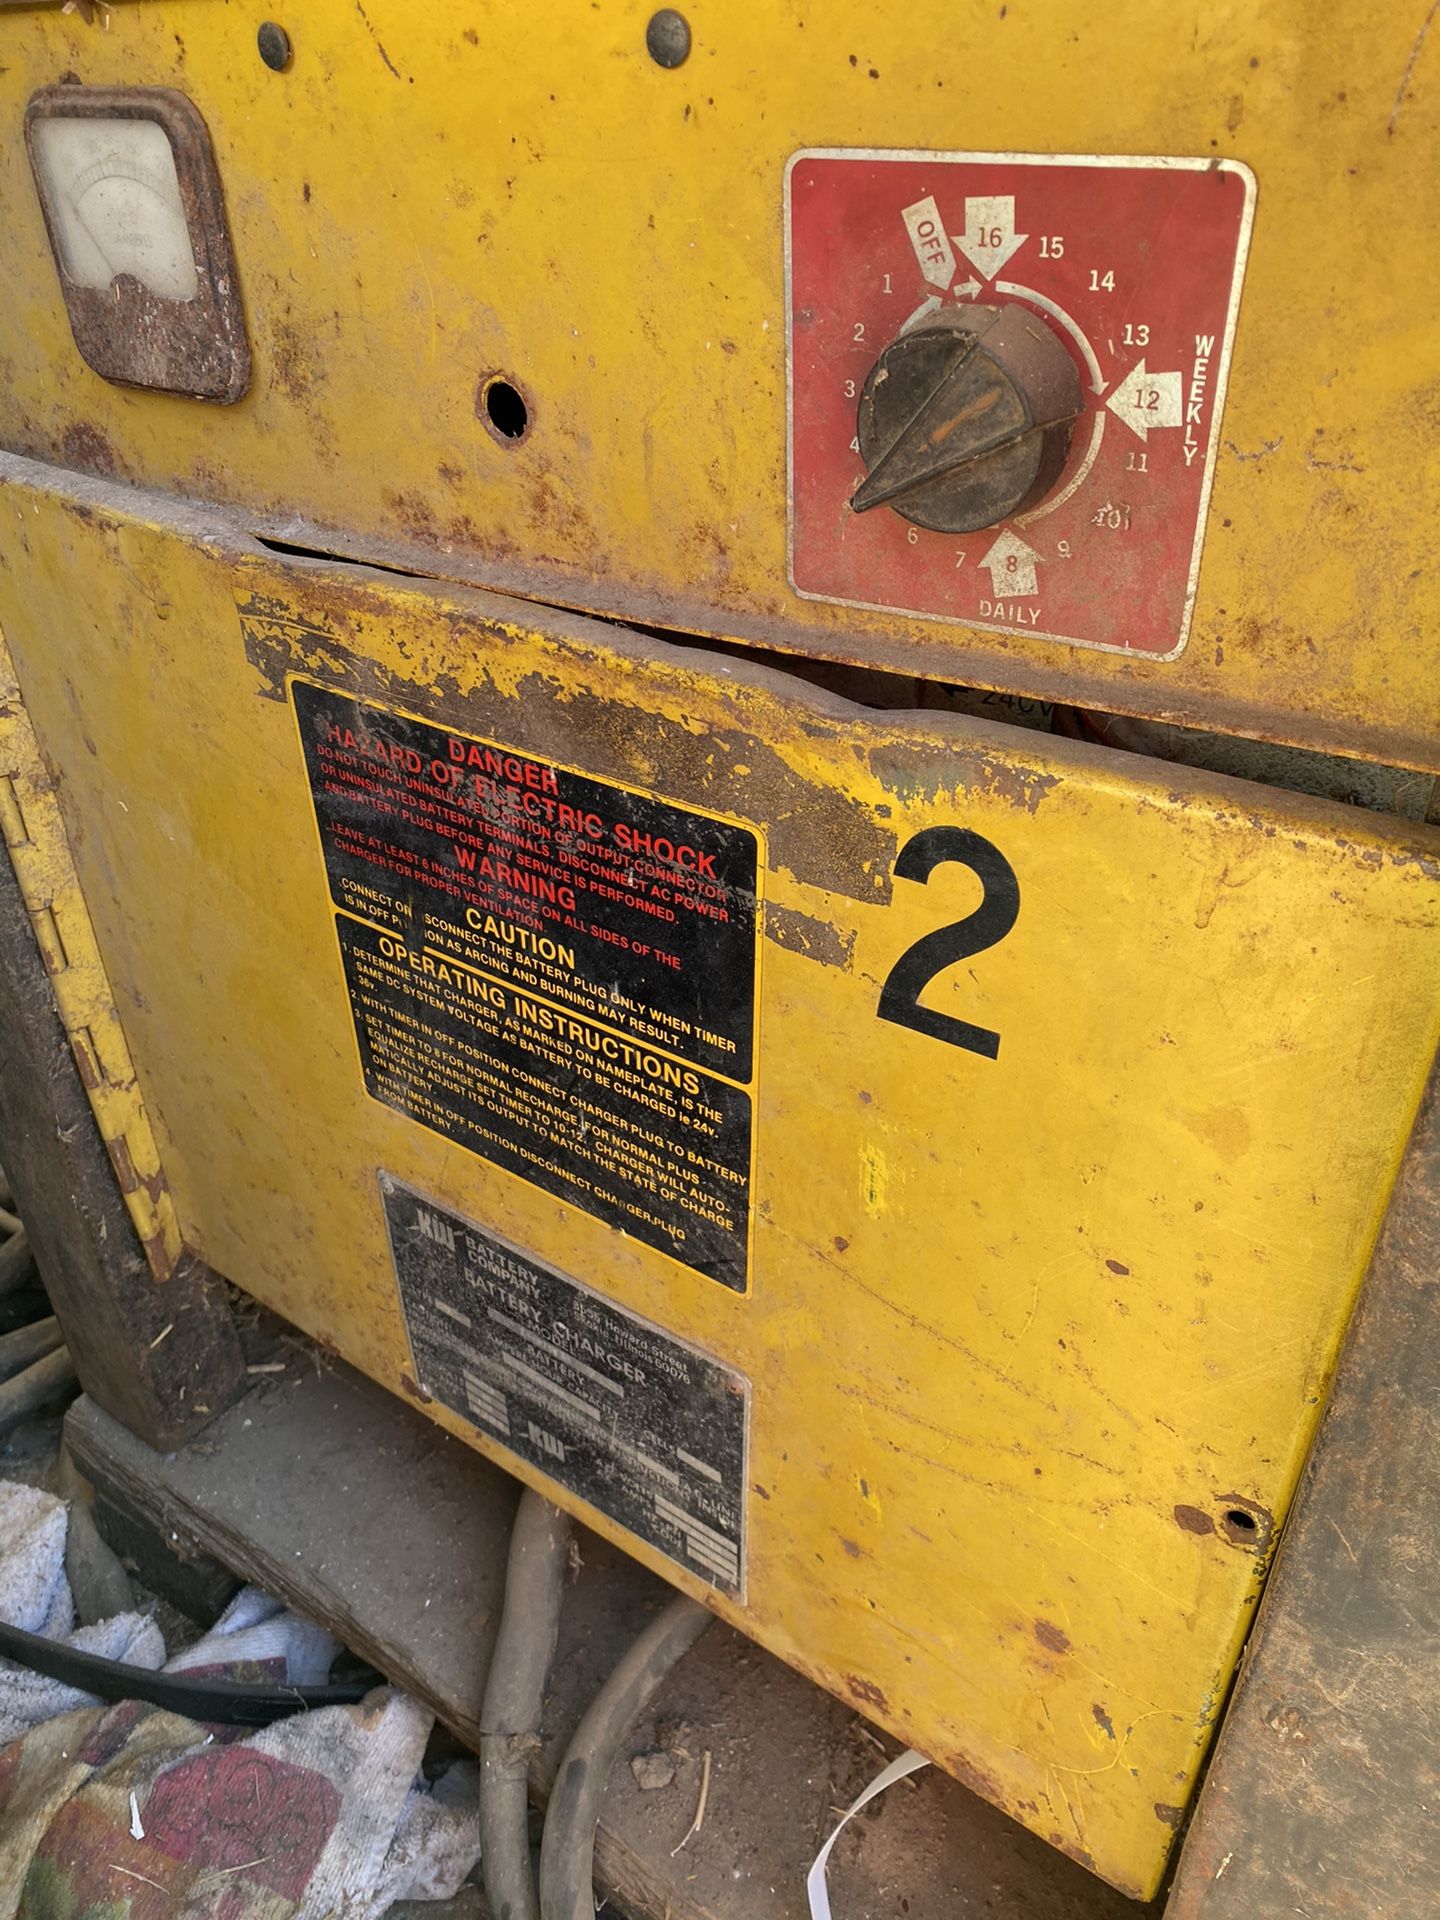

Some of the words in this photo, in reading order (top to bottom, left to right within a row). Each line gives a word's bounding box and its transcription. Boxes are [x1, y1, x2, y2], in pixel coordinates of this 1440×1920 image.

[917, 220, 945, 265] OFF
[978, 227, 1002, 247] 16
[1039, 237, 1064, 258] 15
[883, 275, 892, 292] 1
[1088, 271, 1115, 291] 14
[853, 324, 864, 341] 2
[1122, 325, 1150, 345] 13
[844, 381, 855, 397] 3
[1134, 391, 1160, 410] 12
[1183, 335, 1214, 466] WEEKLY
[1127, 453, 1148, 472] 11
[908, 528, 917, 544] 6
[957, 552, 966, 568] 7
[1006, 556, 1018, 572] 8
[1058, 541, 1070, 558] 9
[979, 600, 1042, 625] DAILY
[447, 737, 558, 796] DANGER
[324, 720, 422, 775] HAZARD
[430, 757, 465, 790] OF
[474, 772, 602, 839] ELECTRIC
[614, 821, 717, 880] SHOCK
[362, 760, 401, 785] TOUCH
[576, 837, 629, 868] OUTPUT
[634, 858, 726, 903] CONNECTOR
[319, 761, 337, 777] OR
[337, 768, 416, 807] UNINSULATED
[419, 798, 473, 828] BATTERY
[477, 819, 553, 858] TERMINALS.
[559, 849, 646, 893] DISCONNECT
[650, 883, 669, 902] AC
[675, 892, 728, 923] POWER
[402, 809, 432, 831] PLUG
[435, 822, 483, 850] BEFORE
[486, 841, 512, 861] ANY
[516, 852, 570, 883] SERVICE
[574, 874, 586, 889] IS
[590, 880, 679, 925] PERFORMED.
[331, 822, 365, 844] LEAVE
[367, 836, 381, 850] AT
[384, 842, 419, 865] LEAST
[421, 857, 429, 869] 6
[431, 861, 475, 888] INCHES
[477, 879, 494, 895] OF
[497, 887, 538, 913] SPACE
[541, 904, 560, 922] ON
[564, 913, 587, 933] ALL
[590, 923, 627, 949] SIDES
[631, 940, 650, 958] OF
[653, 948, 680, 970] THE
[334, 838, 386, 867] CHARGER
[389, 860, 412, 878] FOR
[414, 870, 461, 897] PROPER
[463, 890, 546, 932] VENTILATION.
[454, 844, 575, 911] WARNING
[340, 876, 393, 908] CONNECT
[489, 939, 513, 959] THE
[515, 950, 570, 983] BATTERY
[573, 975, 606, 999] PLUG
[610, 990, 645, 1015] ONLY
[650, 1007, 690, 1035] WHEN
[694, 1026, 736, 1054] TIMER
[465, 906, 575, 970] CAUTION
[876, 825, 1021, 1061] 2
[344, 893, 354, 907] IS
[355, 898, 367, 912] IN
[368, 904, 389, 922] OFF
[446, 937, 461, 953] AS
[464, 945, 508, 973] ARCING
[512, 965, 537, 986] AND
[540, 977, 594, 1010] BURNING
[597, 1002, 625, 1024] MAY
[629, 1016, 684, 1049] RESULT.
[352, 946, 411, 981] DETERMINE
[412, 973, 441, 994] THAT
[443, 987, 501, 1022] CHARGER,
[504, 1015, 520, 1031] AS
[522, 1023, 572, 1055] MARKED
[575, 1047, 593, 1064] ON
[596, 1057, 677, 1103] NAMEPLATE,
[681, 1096, 692, 1110] IS
[696, 1102, 722, 1124] THE
[355, 961, 384, 982] SAME
[385, 975, 400, 990] DC
[403, 983, 444, 1010] SYSTEM
[446, 1003, 498, 1036] VOLTAGE
[501, 1028, 516, 1044] AS
[519, 1037, 571, 1070] BATTERY
[575, 1062, 591, 1079] TO
[594, 1071, 610, 1088] BE
[613, 1080, 674, 1118] CHARGED
[378, 935, 505, 1009] OPERATING
[515, 995, 699, 1097] INSTRUCTIONS
[361, 994, 386, 1013] WITH
[388, 1007, 419, 1029] TIMER
[420, 1022, 432, 1035] IN
[434, 1029, 455, 1047] OFF
[457, 1040, 508, 1072] POSITION
[511, 1065, 566, 1100] CONNECT
[569, 1093, 627, 1130] CHARGER
[631, 1122, 663, 1147] PLUG
[667, 1140, 684, 1157] TO
[687, 1149, 746, 1187] BATTERY
[365, 1013, 383, 1029] SET
[384, 1022, 415, 1045] TIMER
[417, 1038, 432, 1053] TO
[441, 1050, 463, 1069] FOR
[465, 1062, 512, 1093] NORMAL
[584, 1120, 609, 1140] FOR
[612, 1133, 663, 1167] NORMAL
[667, 1161, 699, 1185] PLUS
[372, 1053, 386, 1068] ON
[388, 1062, 436, 1094] BATTERY.
[367, 1027, 415, 1058] EQUALIZE
[417, 1052, 473, 1087] RECHARGE
[476, 1081, 496, 1099] SET
[499, 1092, 532, 1116] TIMER
[535, 1110, 549, 1125] TO
[595, 1139, 653, 1177] CHARGER
[657, 1170, 686, 1193] WILL
[689, 1186, 730, 1215] AUTO-
[370, 1040, 424, 1076] MATICALLY
[427, 1069, 466, 1097] ADJUST
[468, 1089, 484, 1106] ITS
[486, 1099, 529, 1128] OUTPUT
[532, 1121, 547, 1138] TO
[550, 1131, 590, 1159] MATCH
[594, 1152, 615, 1172] THE
[618, 1165, 656, 1193] STATE
[660, 1186, 676, 1203] OF
[680, 1196, 733, 1231] CHARGE
[375, 1072, 400, 1092] WITH
[402, 1086, 431, 1108] TIMER
[433, 1102, 443, 1114] IN
[445, 1108, 466, 1126] OFF
[468, 1120, 517, 1153] POSITION
[520, 1146, 590, 1191] DISCONNECT
[465, 1235, 539, 1287] BATTERY
[467, 1248, 541, 1301] COMPANY
[463, 1266, 542, 1325] BATTERY
[552, 1318, 646, 1387] CHARGER
[527, 1420, 565, 1463] KW
